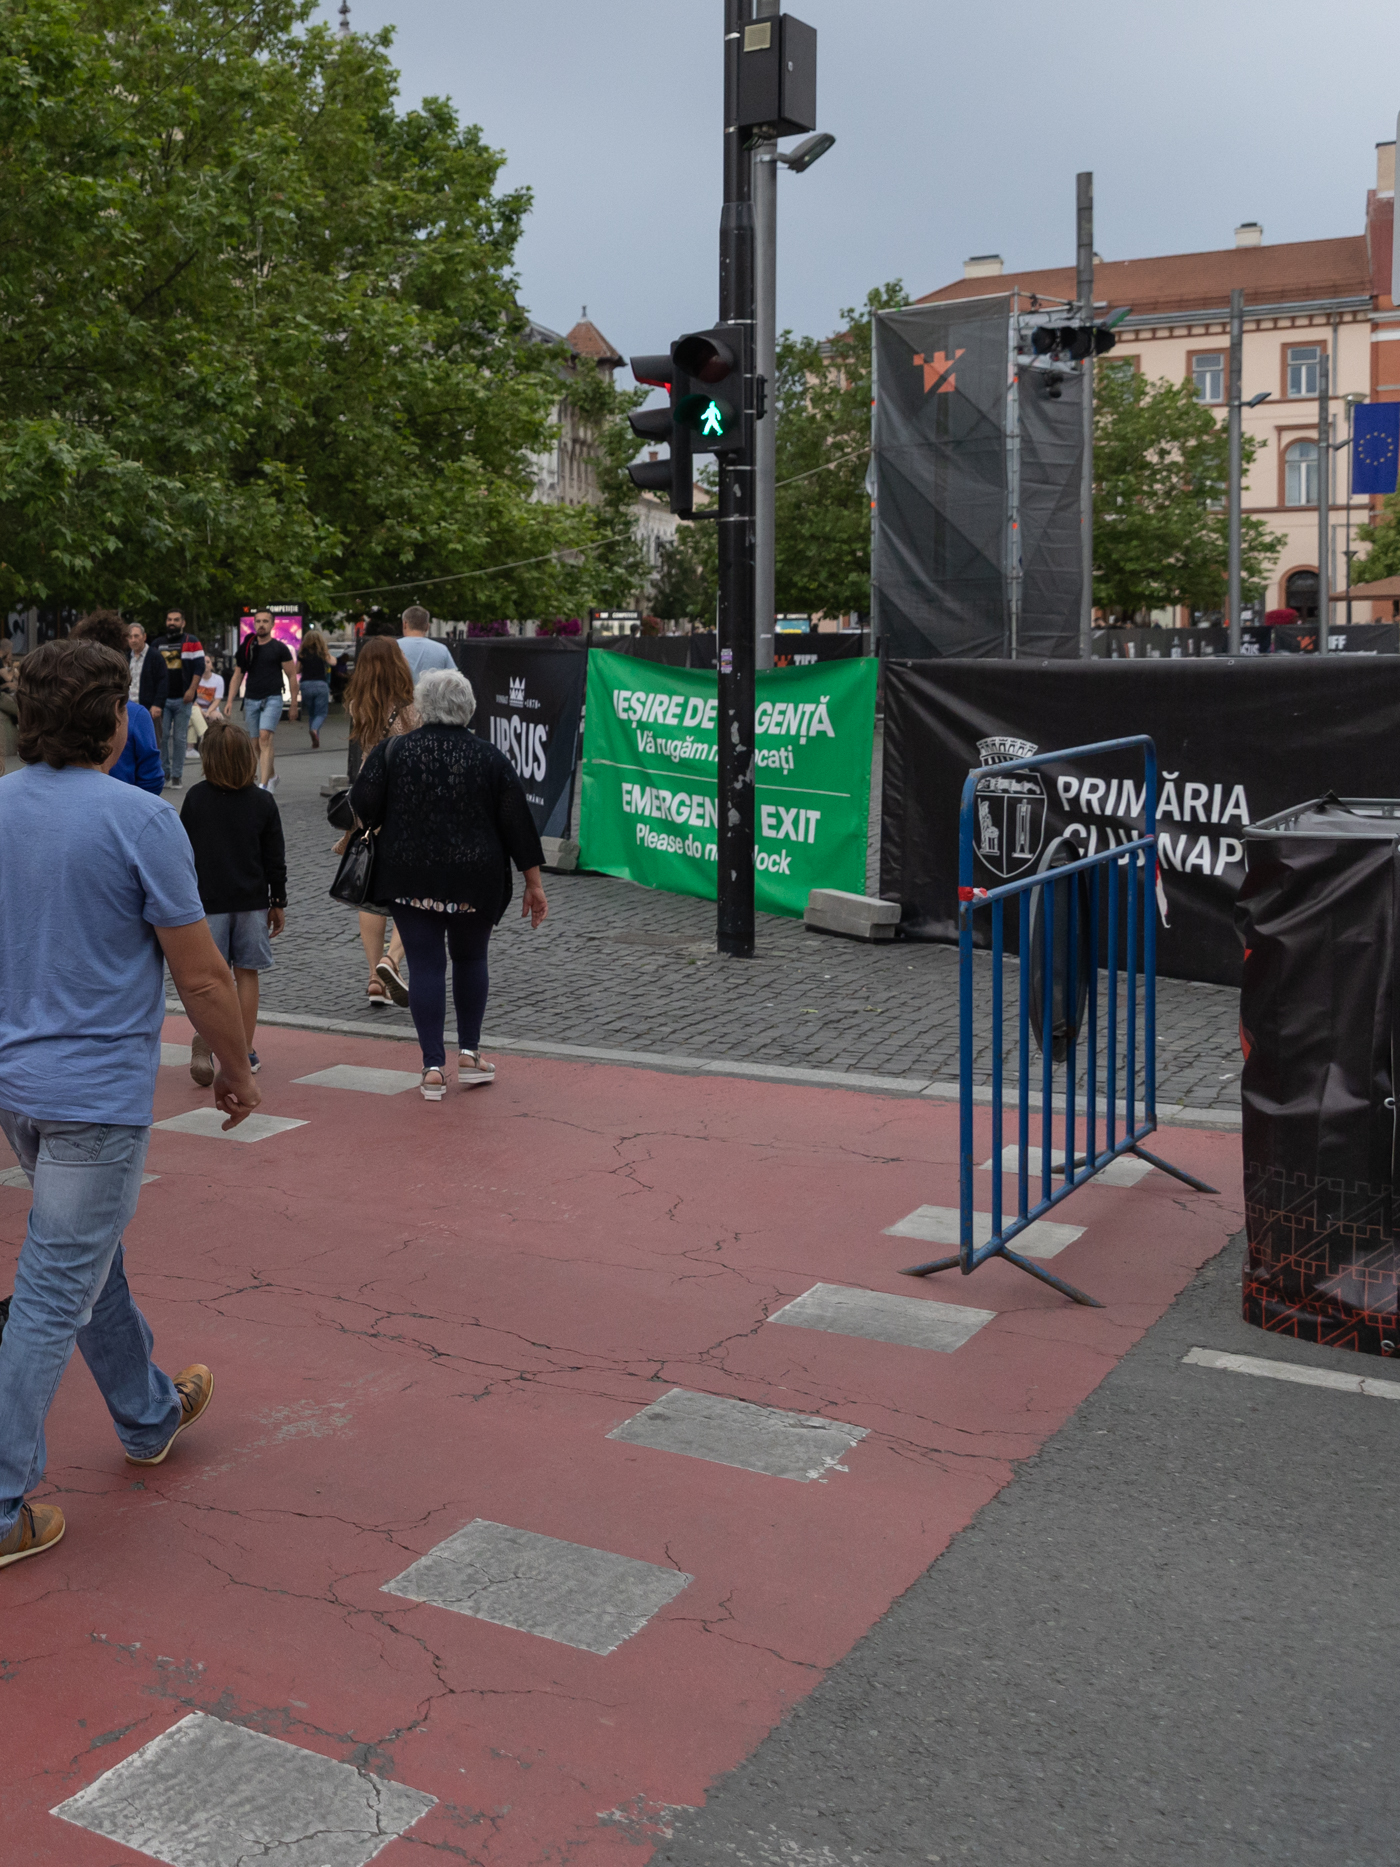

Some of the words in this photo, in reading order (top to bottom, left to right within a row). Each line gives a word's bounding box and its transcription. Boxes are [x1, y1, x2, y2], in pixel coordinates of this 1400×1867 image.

[793, 654, 818, 666] TIFF
[1328, 635, 1347, 650] IFF
[613, 689, 685, 728] IEȘIRE
[683, 696, 718, 729] DE
[754, 695, 836, 745] GENȚĂ
[489, 714, 548, 782] URSUS
[636, 729, 655, 752] Vă
[656, 735, 709, 763] rugăm
[621, 782, 718, 829] EMERGEN
[760, 804, 821, 844] EXIT
[1056, 770, 1251, 826] PRIMĂRIA
[636, 823, 683, 854] Please
[685, 833, 702, 859] do
